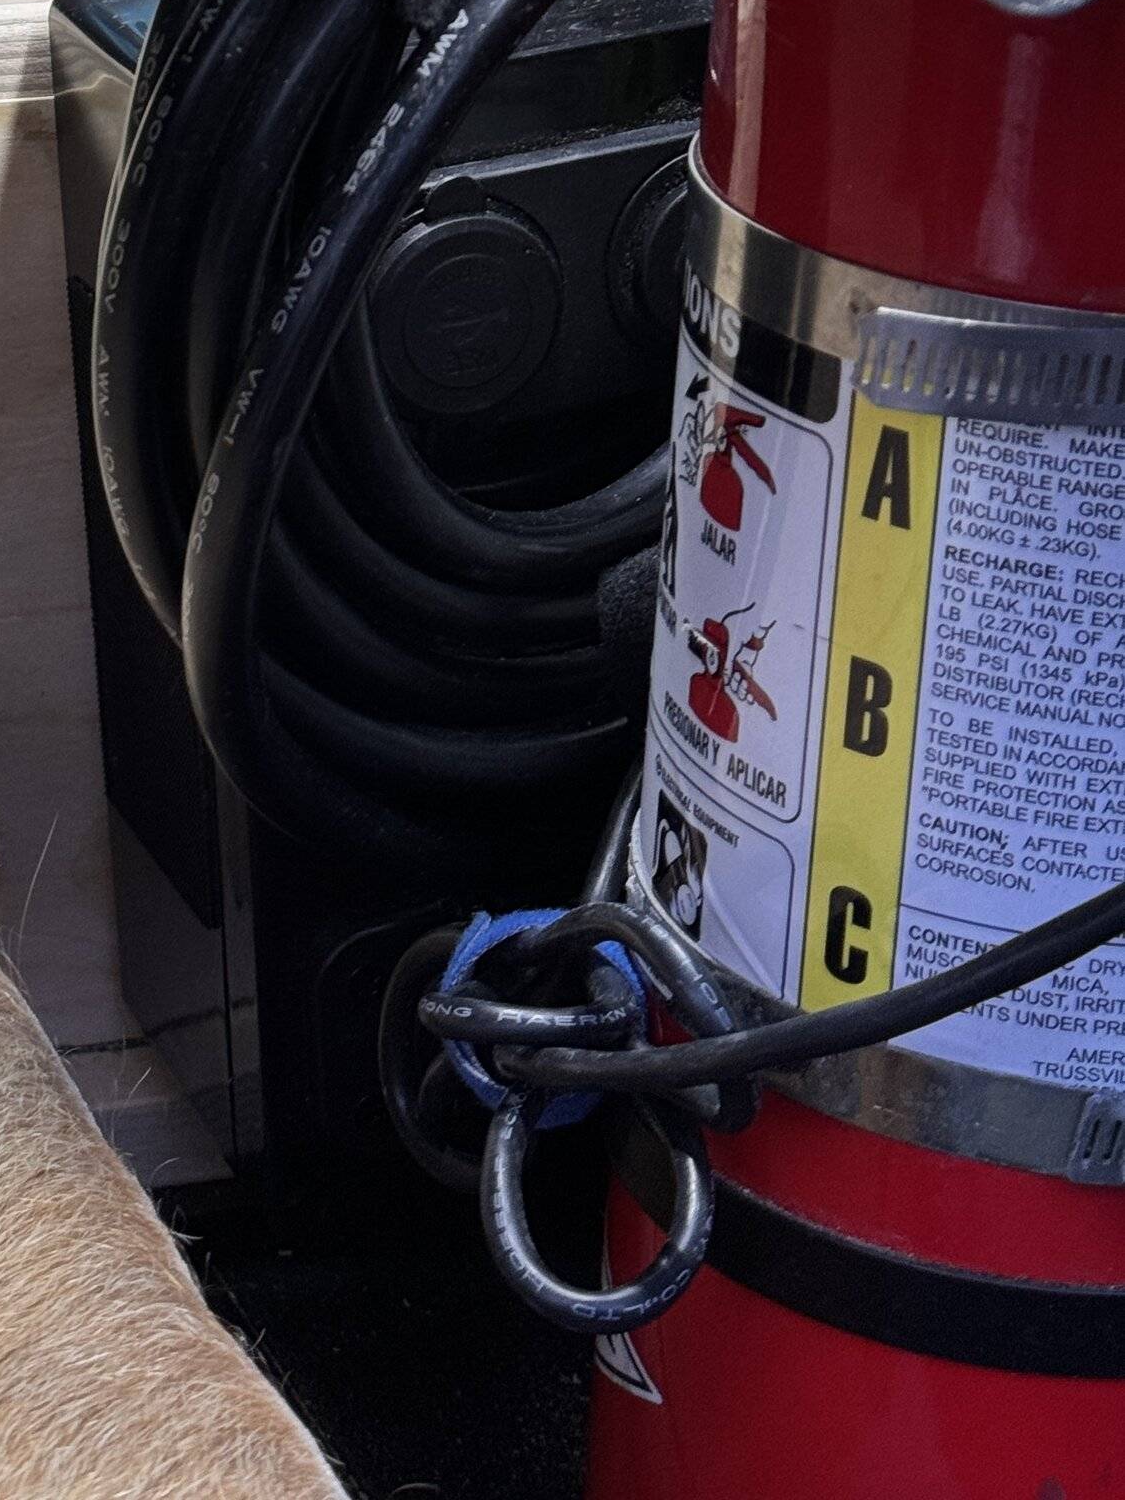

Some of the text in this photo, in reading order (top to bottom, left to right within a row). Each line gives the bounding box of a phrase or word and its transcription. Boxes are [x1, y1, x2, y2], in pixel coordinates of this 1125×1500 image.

[417, 8, 468, 78] AWM
[861, 424, 912, 531] A
[952, 458, 1053, 491] OPERABLE
[951, 477, 1125, 520] IN PLACE. GRO
[947, 518, 1015, 545] (4.00KG
[949, 498, 1122, 541] (INCLUDING HOSE
[942, 565, 984, 587] USE.
[991, 575, 1067, 601] PARTIAL
[945, 545, 1063, 581] RECHARGE:
[941, 584, 965, 601] TO
[971, 592, 1023, 615] LEAK.
[1031, 603, 1084, 624] HAVE
[937, 623, 1036, 657] CHEMICAL
[1043, 646, 1086, 664] AND
[939, 604, 961, 622] LB
[978, 613, 1057, 643] (2.27KG)
[1075, 630, 1103, 646] OF
[933, 662, 1063, 700] DISTRIBUTOR
[937, 644, 966, 663] 195
[977, 653, 1009, 672] PSI
[1022, 662, 1072, 683] (1345
[843, 654, 892, 757] B
[931, 682, 1010, 712] SERVICE
[1015, 700, 1094, 726] MANUAL
[927, 728, 997, 757] TESTED
[1003, 745, 1023, 762] IN
[929, 708, 1117, 757] TO BE INSTALLED,
[726, 752, 787, 809] APLICAR
[925, 748, 1017, 780] SUPPLIED
[1026, 768, 1076, 790] WITH
[923, 767, 964, 789] FIRE
[974, 778, 1096, 813] PROTECTION
[1034, 810, 1078, 830] FIRE
[917, 833, 1125, 882] SURFACES CONTACTE
[1024, 836, 1087, 859] AFTER
[915, 853, 1036, 893] CORROSION.
[824, 885, 873, 986] C
[1011, 988, 1069, 1012] DUST,
[1051, 974, 1109, 995] MICA,
[1016, 1011, 1086, 1034] UNDER
[1034, 1061, 1125, 1084] TRUSSVIL
[1067, 1048, 1125, 1064] AMER
